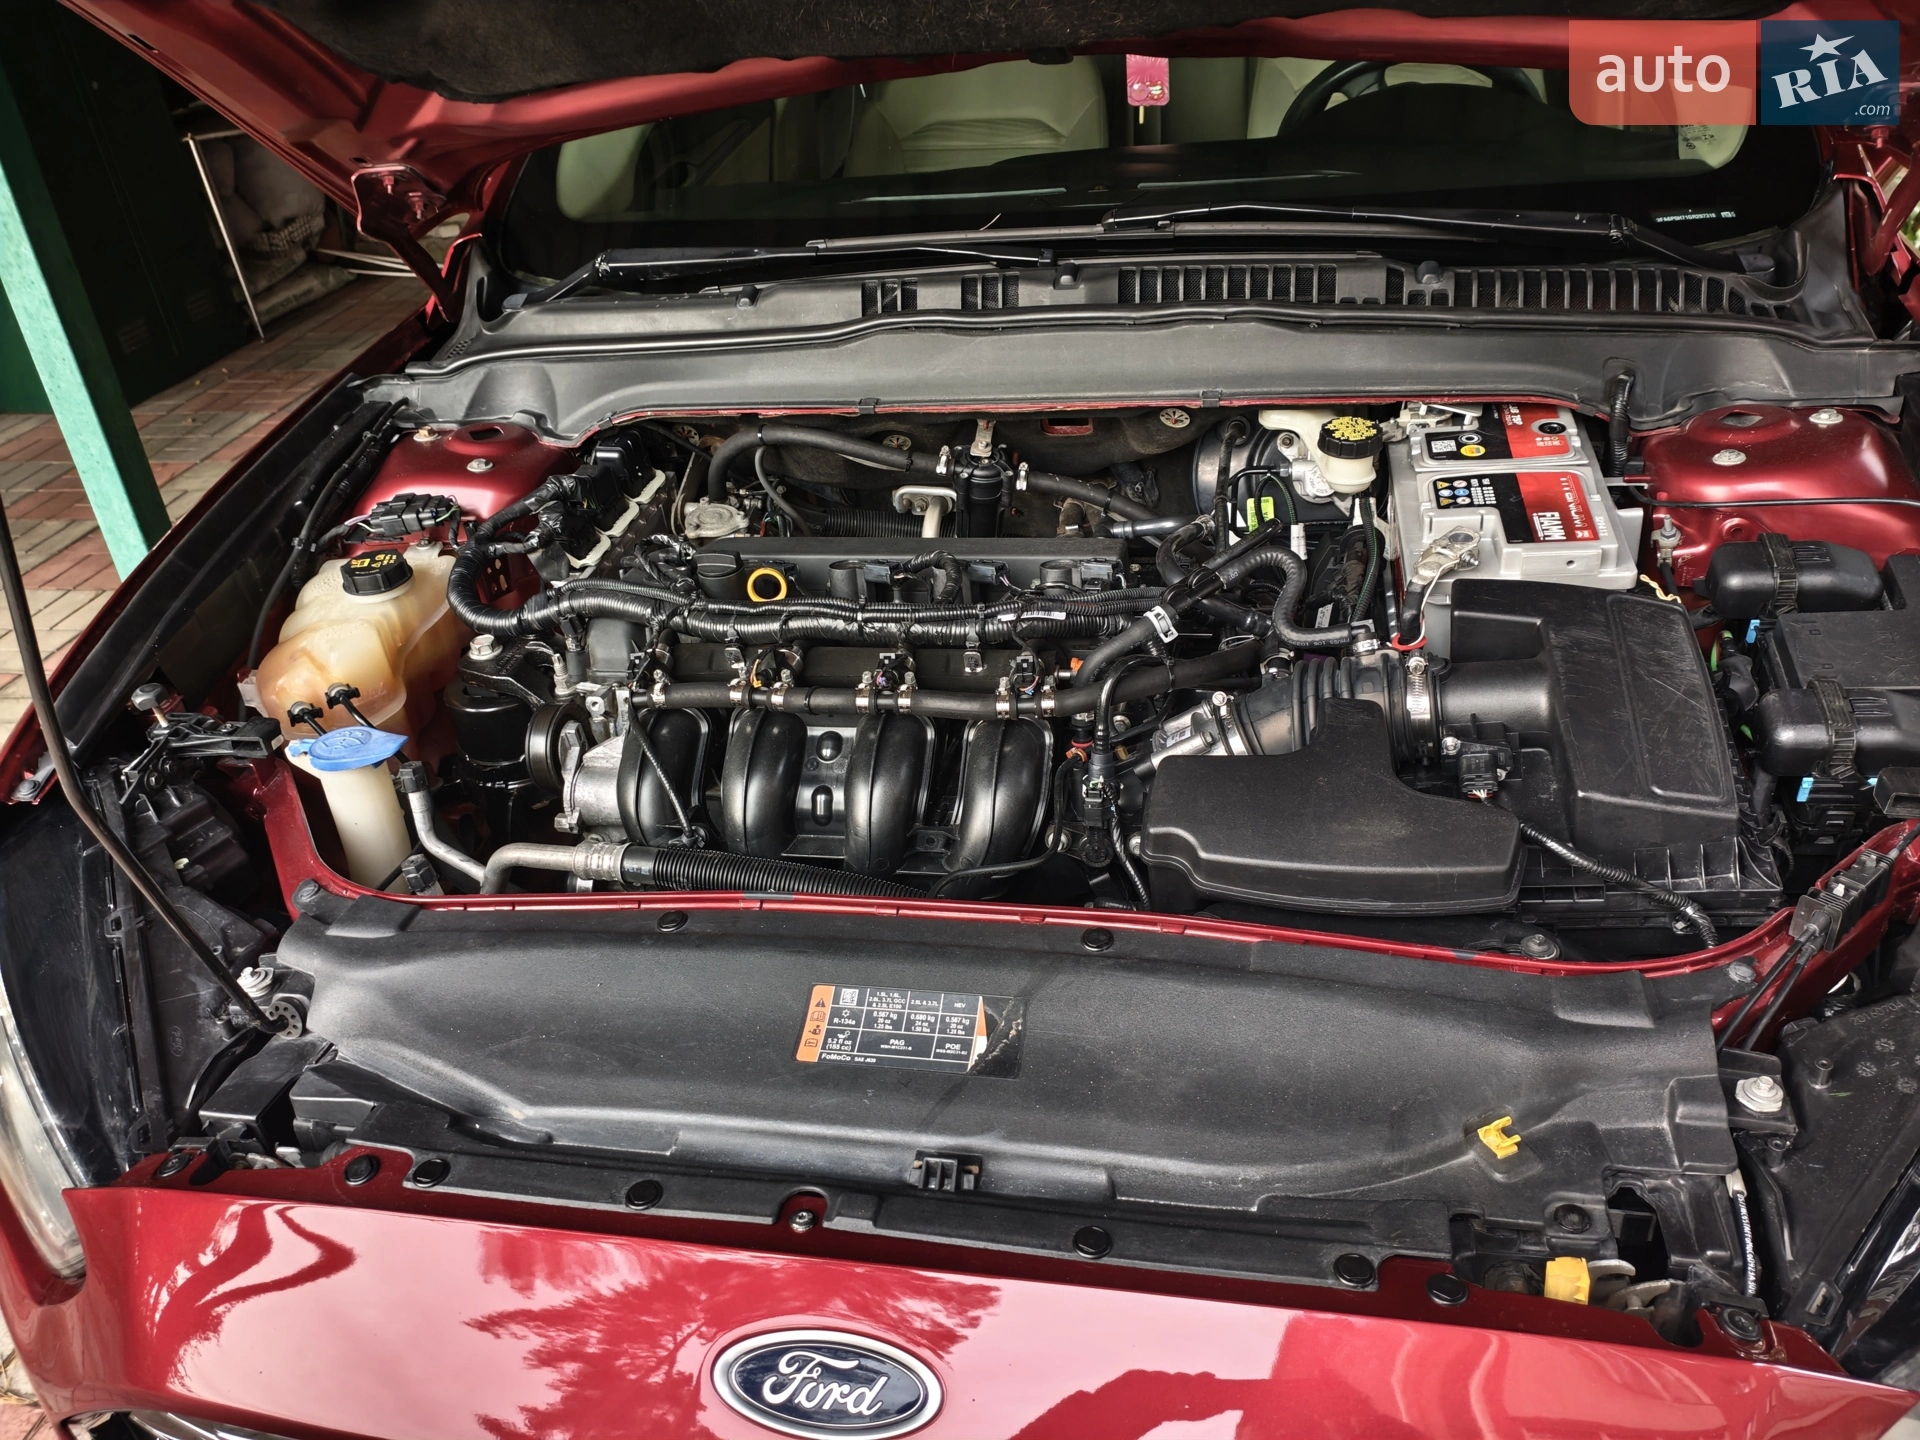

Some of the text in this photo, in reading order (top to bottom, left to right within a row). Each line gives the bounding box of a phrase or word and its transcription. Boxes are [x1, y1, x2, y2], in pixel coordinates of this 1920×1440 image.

[1538, 512, 1566, 540] FIAMM
[889, 1012, 898, 1020] kg
[762, 1350, 889, 1416] Ford
